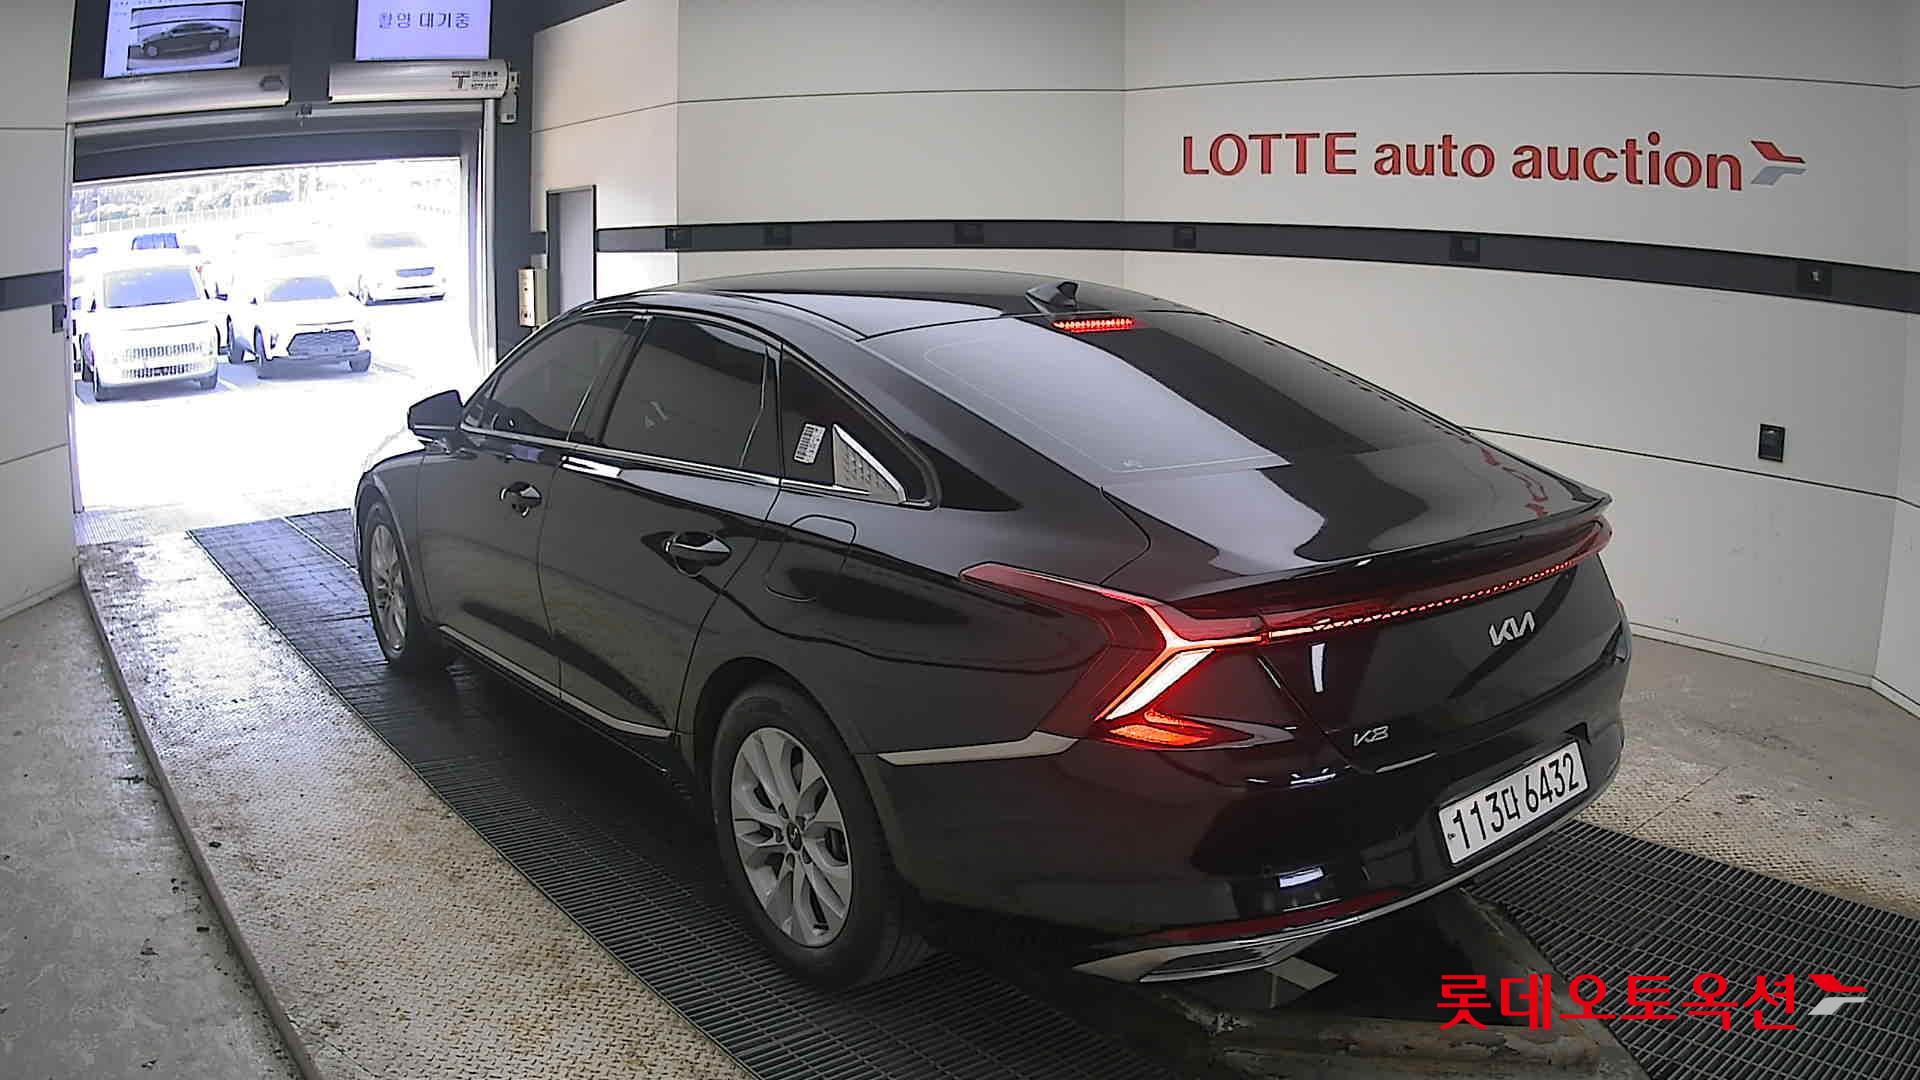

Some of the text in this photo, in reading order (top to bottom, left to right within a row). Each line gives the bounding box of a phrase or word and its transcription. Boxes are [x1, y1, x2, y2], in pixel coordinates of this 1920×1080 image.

[419, 11, 470, 29] 대기중
[1182, 132, 1743, 191] LOTTE auto auction
[1489, 611, 1536, 646] KIA
[1353, 726, 1390, 746] K8
[1453, 752, 1580, 849] 113다 6432
